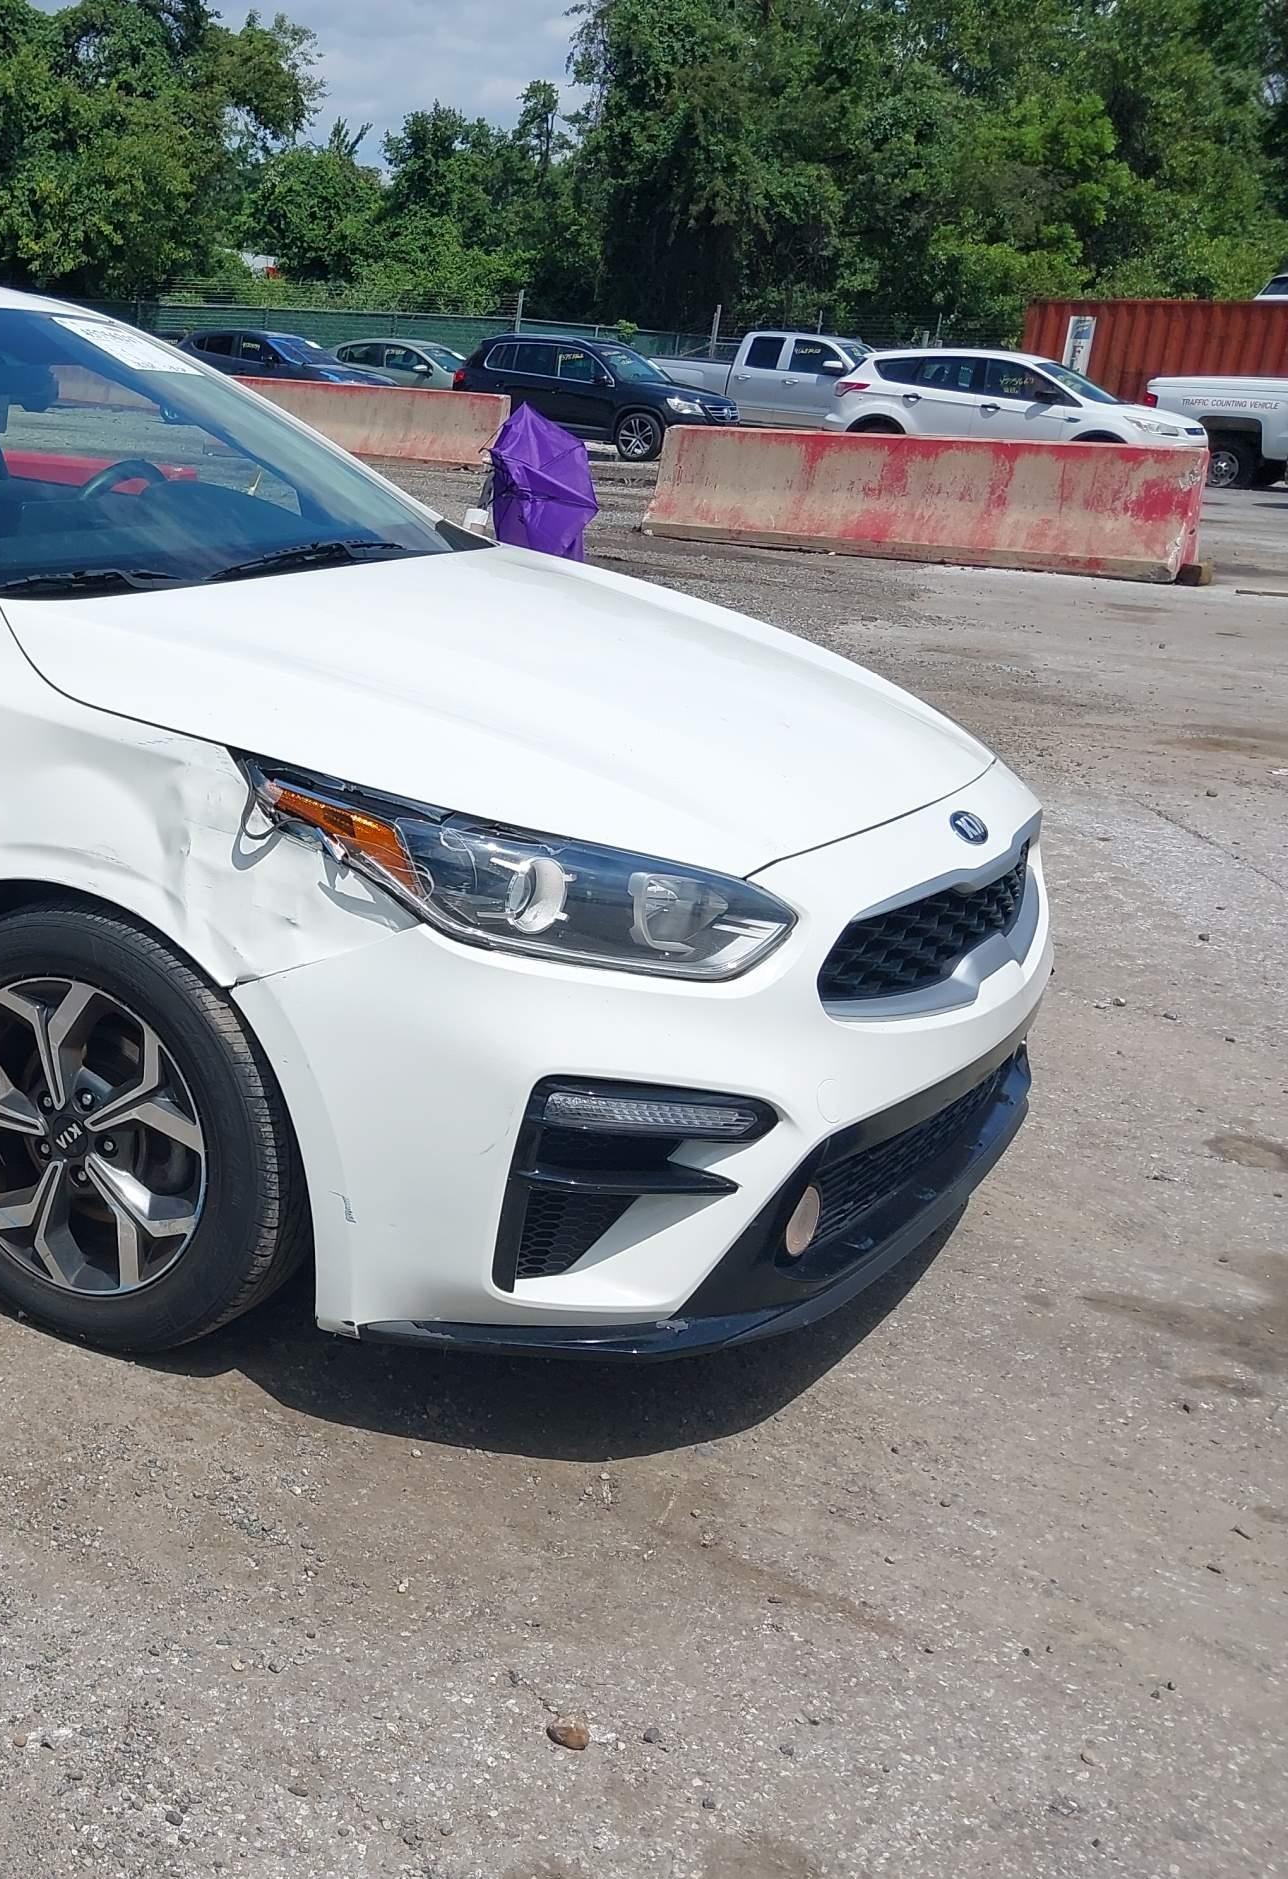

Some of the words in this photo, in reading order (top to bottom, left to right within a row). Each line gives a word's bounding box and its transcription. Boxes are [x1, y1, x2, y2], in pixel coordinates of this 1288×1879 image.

[1182, 398, 1209, 407] TRAFFIC
[1211, 399, 1248, 408] COUNTING
[1249, 400, 1281, 410] VEHICLE
[55, 1122, 83, 1150] KIA
